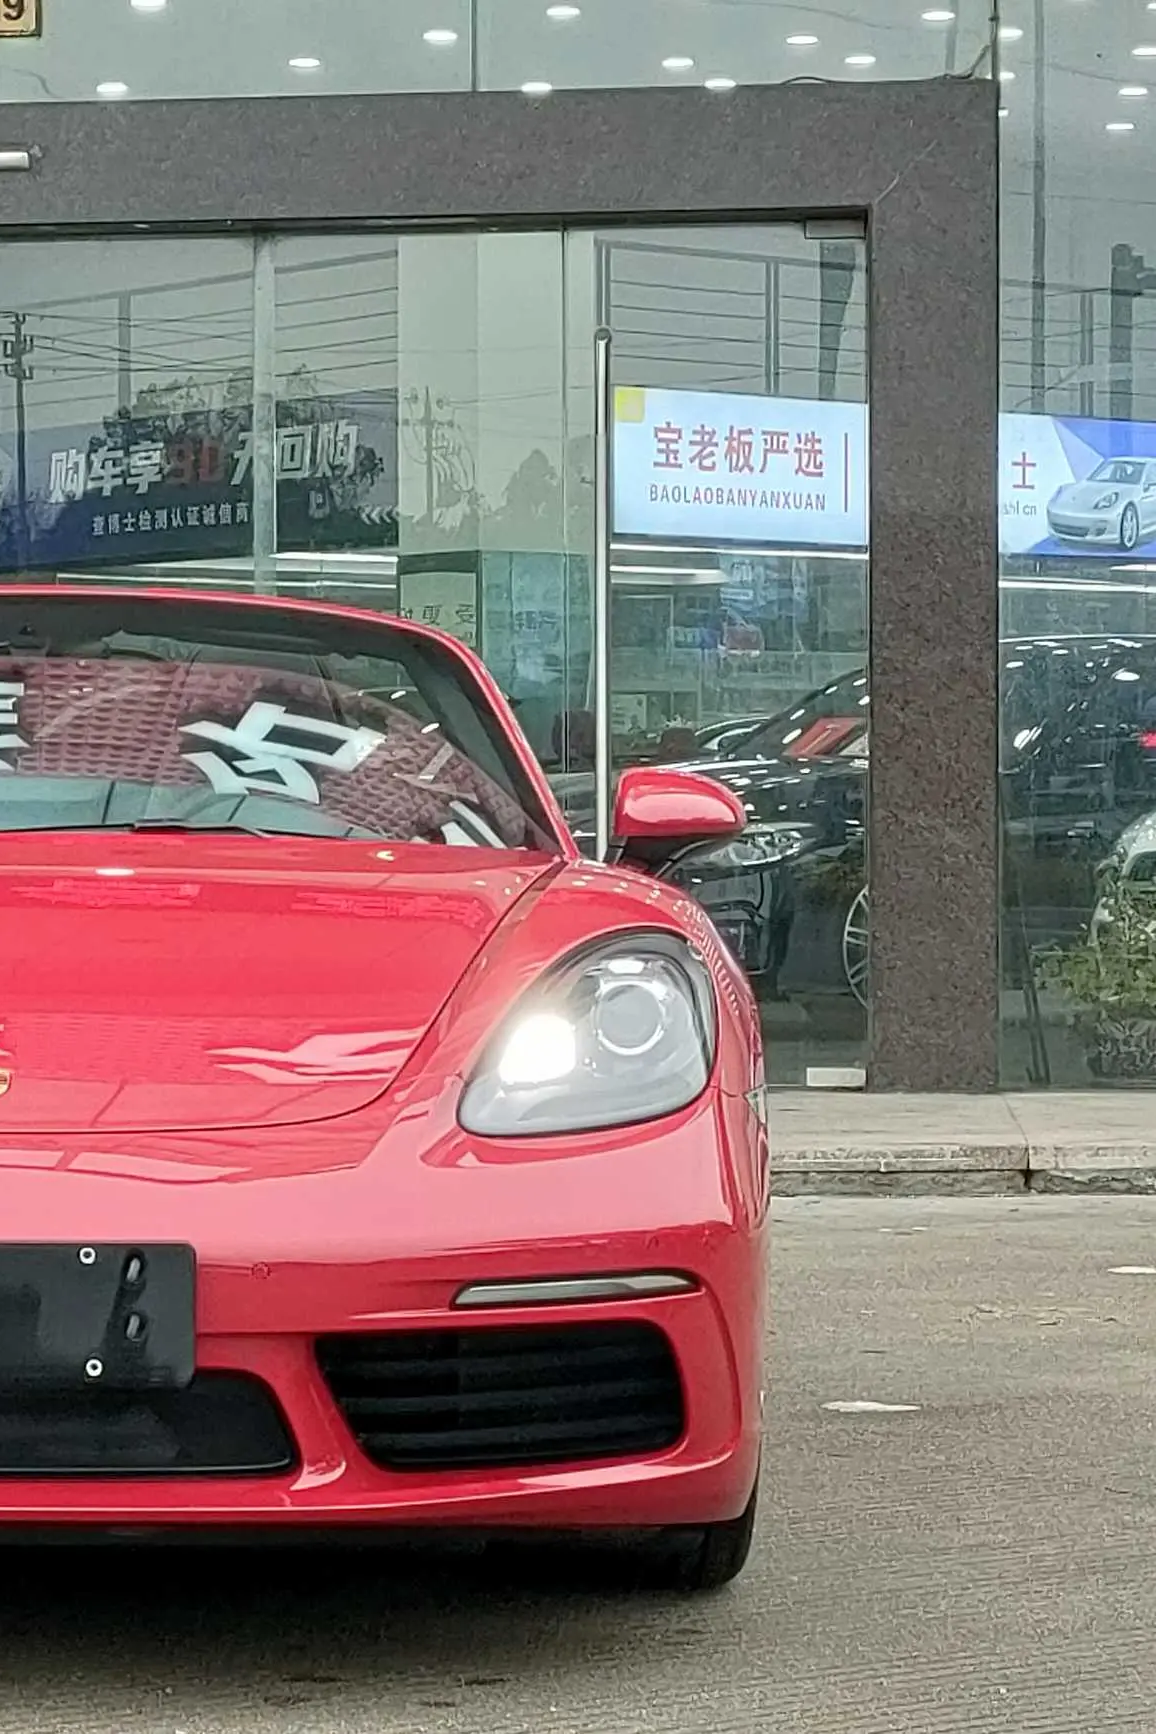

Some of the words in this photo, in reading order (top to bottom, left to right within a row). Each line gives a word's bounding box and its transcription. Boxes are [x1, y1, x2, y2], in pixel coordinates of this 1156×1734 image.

[650, 421, 824, 478] 宝老板严选
[649, 483, 826, 511] BAOLAOBANYANXUAN
